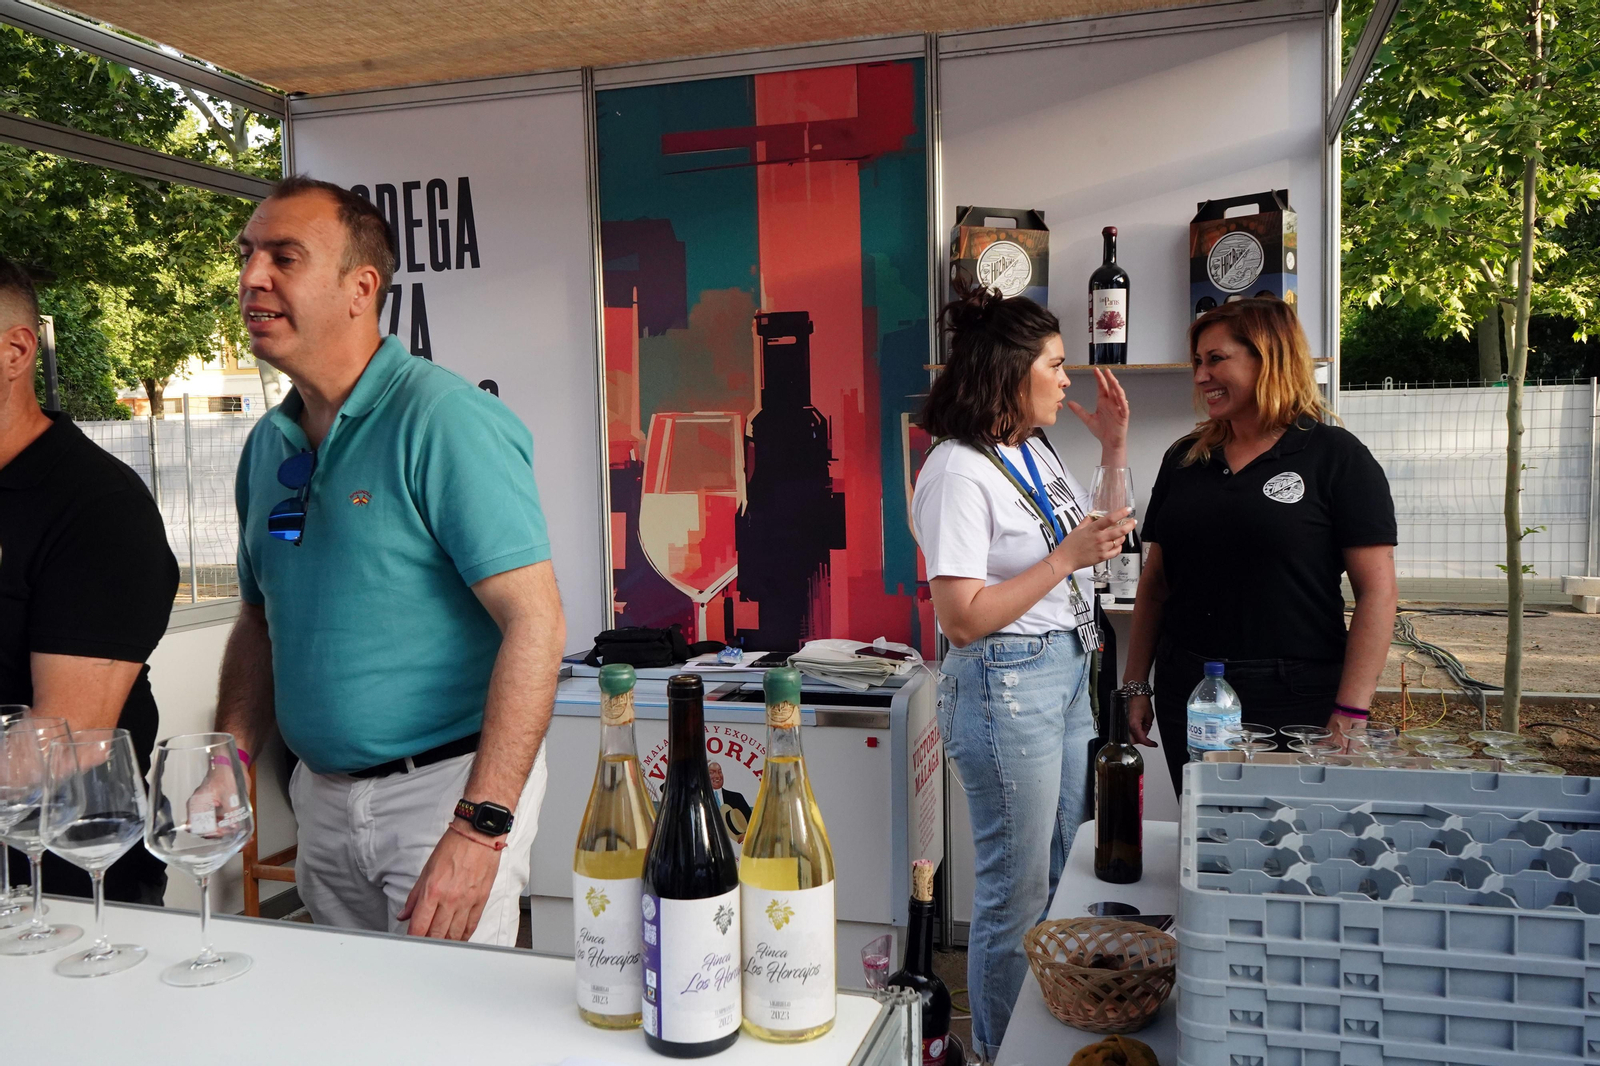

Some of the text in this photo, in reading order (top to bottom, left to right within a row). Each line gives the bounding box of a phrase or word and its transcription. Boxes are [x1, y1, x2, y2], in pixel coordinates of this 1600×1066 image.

[1076, 621, 1101, 654] STAFF
[579, 926, 606, 945] Finca
[587, 945, 641, 973] Horcajos
[755, 941, 789, 960] Finca
[701, 951, 732, 971] Finca
[744, 956, 822, 986] Los Horcajos
[680, 972, 710, 995] Los
[591, 993, 609, 1006] 2023
[718, 1014, 734, 1029] 2023
[770, 1009, 790, 1021] 2023
